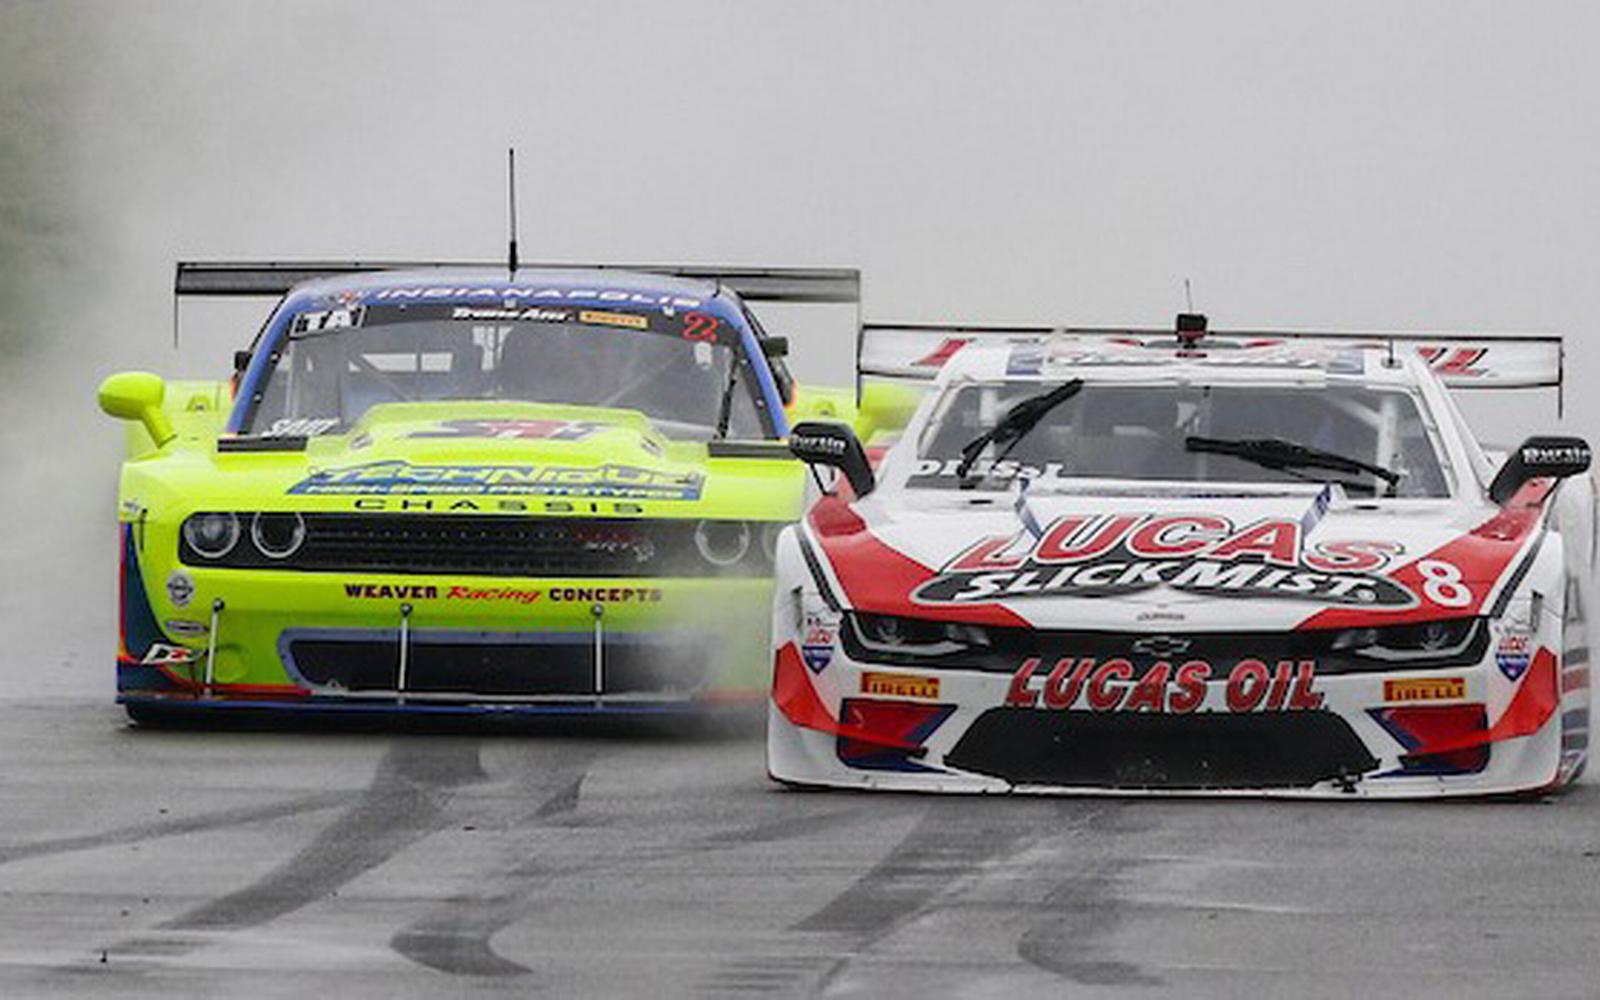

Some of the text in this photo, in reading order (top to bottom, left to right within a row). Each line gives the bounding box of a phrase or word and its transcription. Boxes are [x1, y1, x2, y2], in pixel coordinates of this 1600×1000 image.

[377, 287, 701, 307] INDIANAPOLIS
[302, 309, 351, 333] TA
[354, 498, 643, 513] CHASSIS
[942, 513, 1406, 574] LUCAS
[343, 584, 663, 604] WEAVER Racing CONCEPTS
[1416, 559, 1473, 608] 8
[1004, 656, 1325, 714] LUCAS OIL
